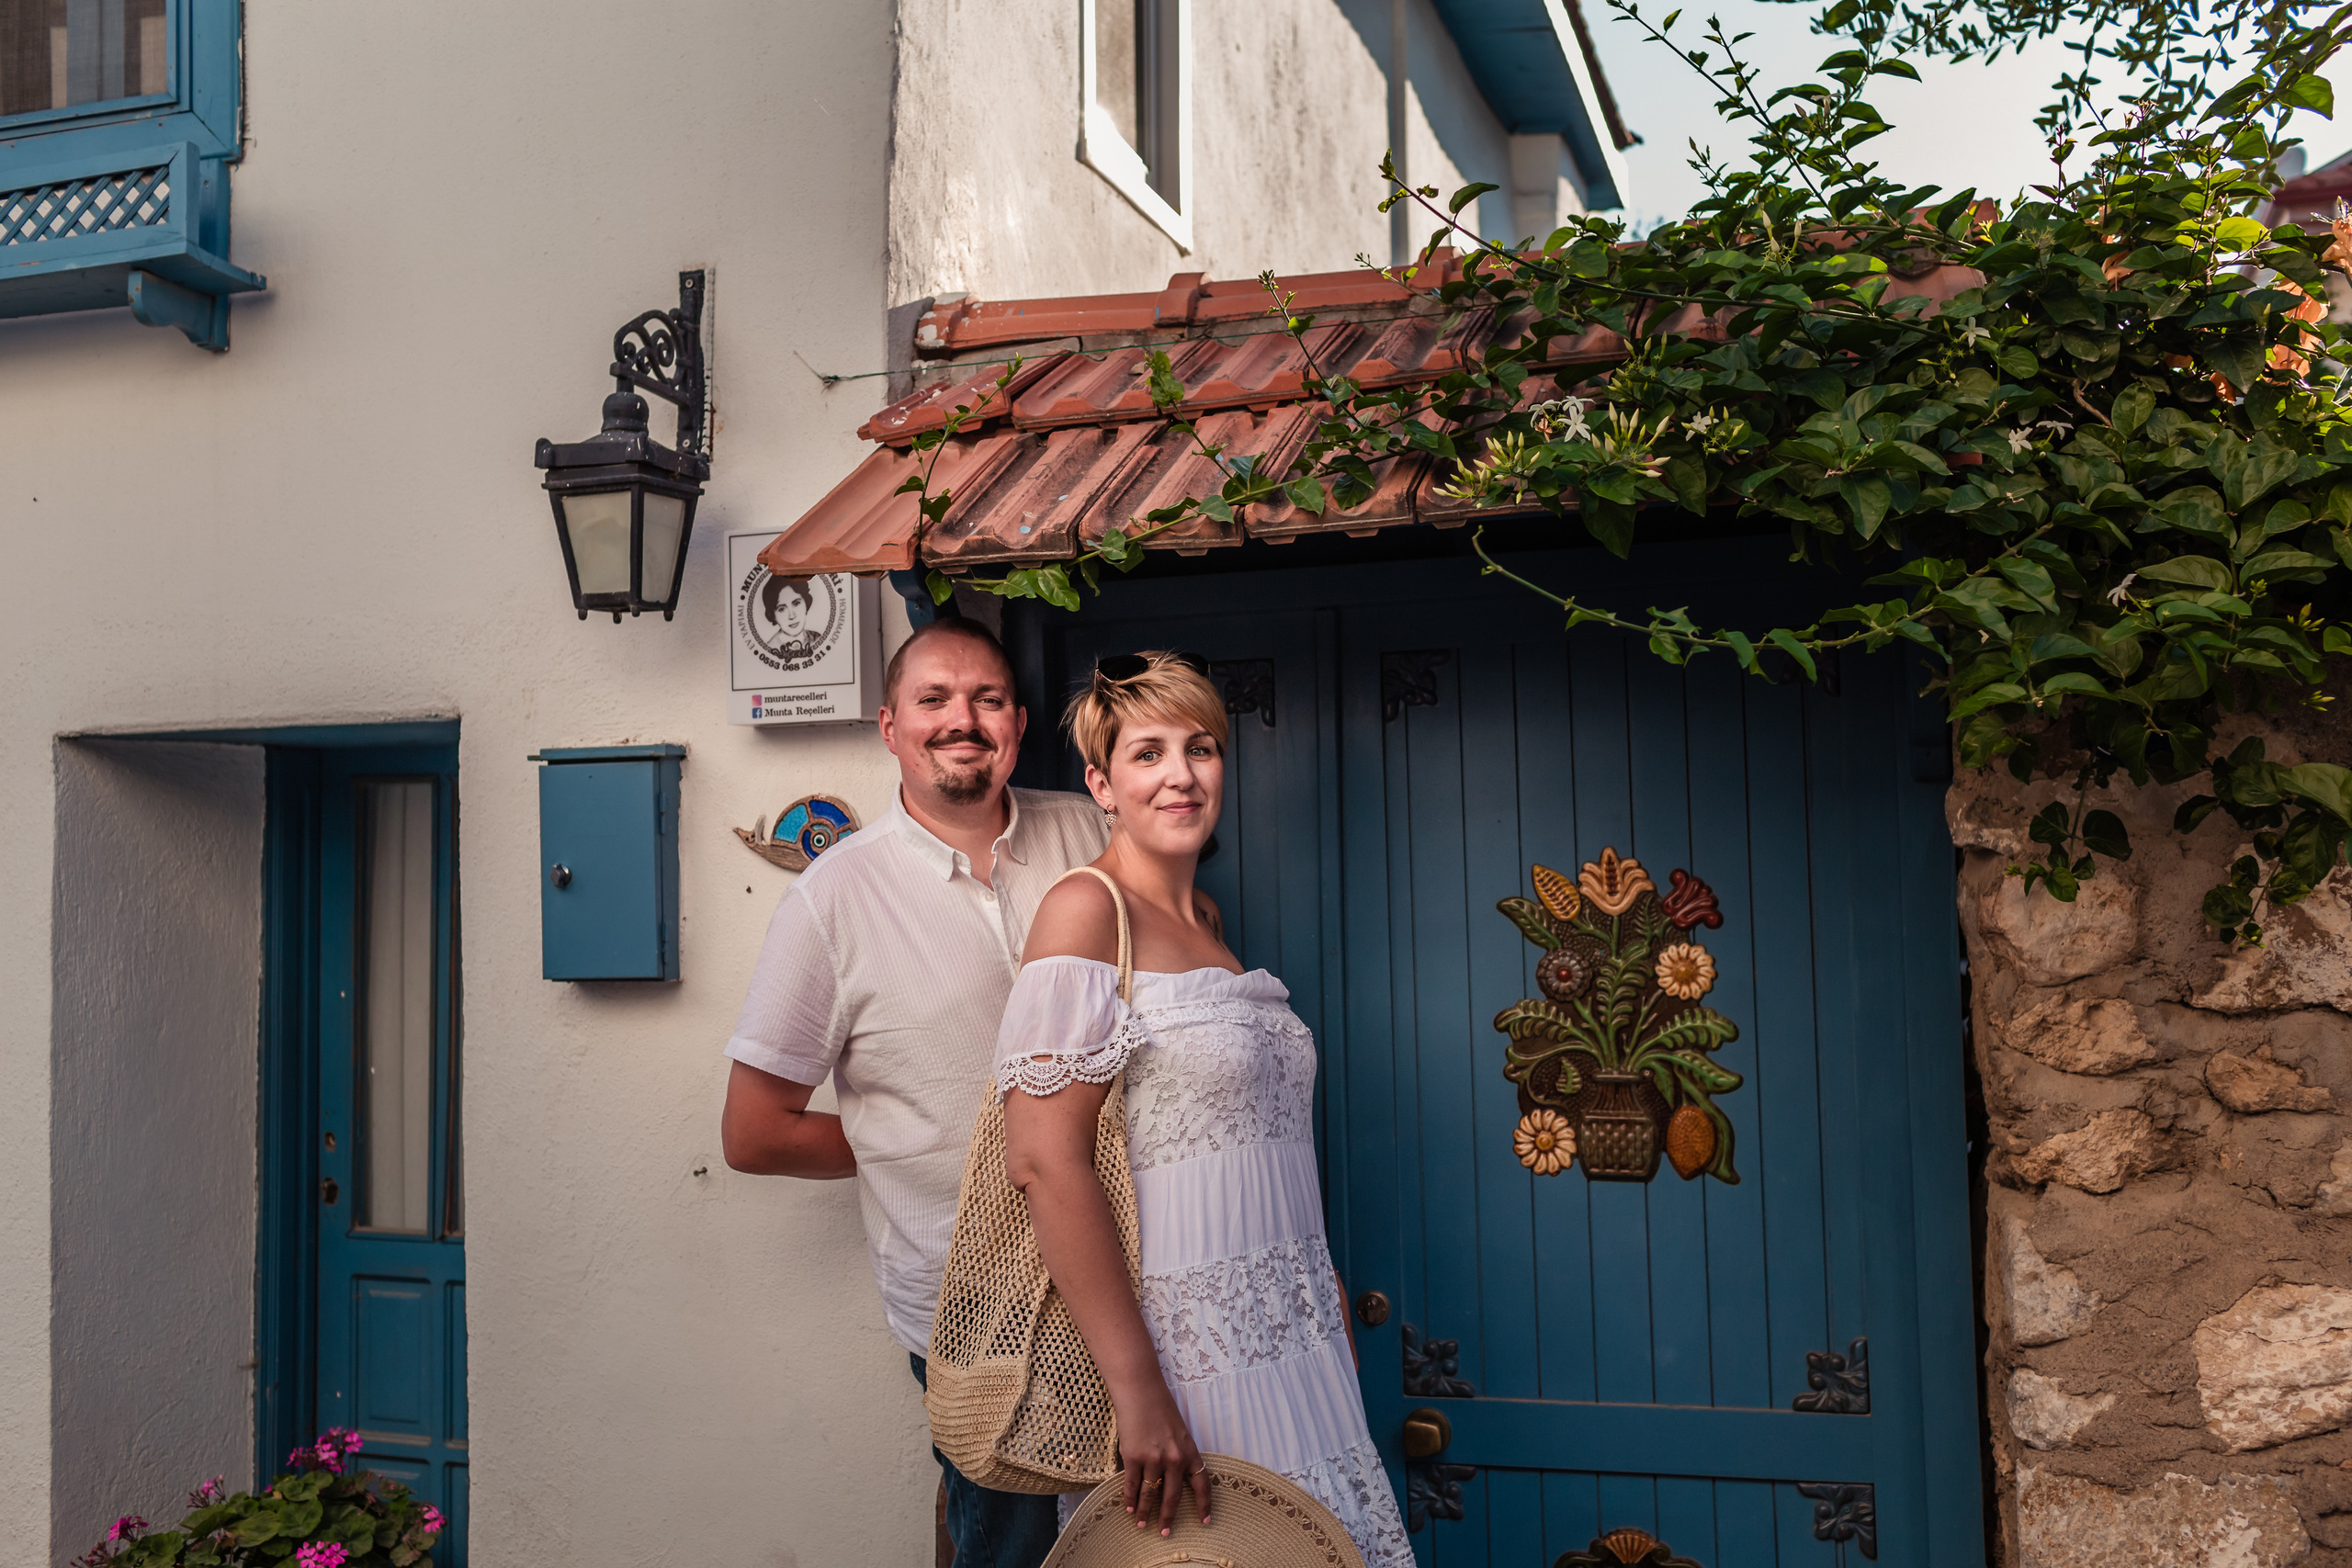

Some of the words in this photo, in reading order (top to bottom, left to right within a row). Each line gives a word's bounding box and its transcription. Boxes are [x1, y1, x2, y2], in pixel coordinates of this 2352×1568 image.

[830, 598, 846, 644] HOMEMADE
[745, 639, 755, 650] EV
[759, 653, 781, 670] 0553
[782, 663, 800, 671] 068
[802, 659, 814, 669] 33
[814, 650, 826, 661] 31
[764, 692, 827, 704] muntarecelleri
[764, 708, 793, 717] Munta
[796, 705, 835, 716] Reçelleri
